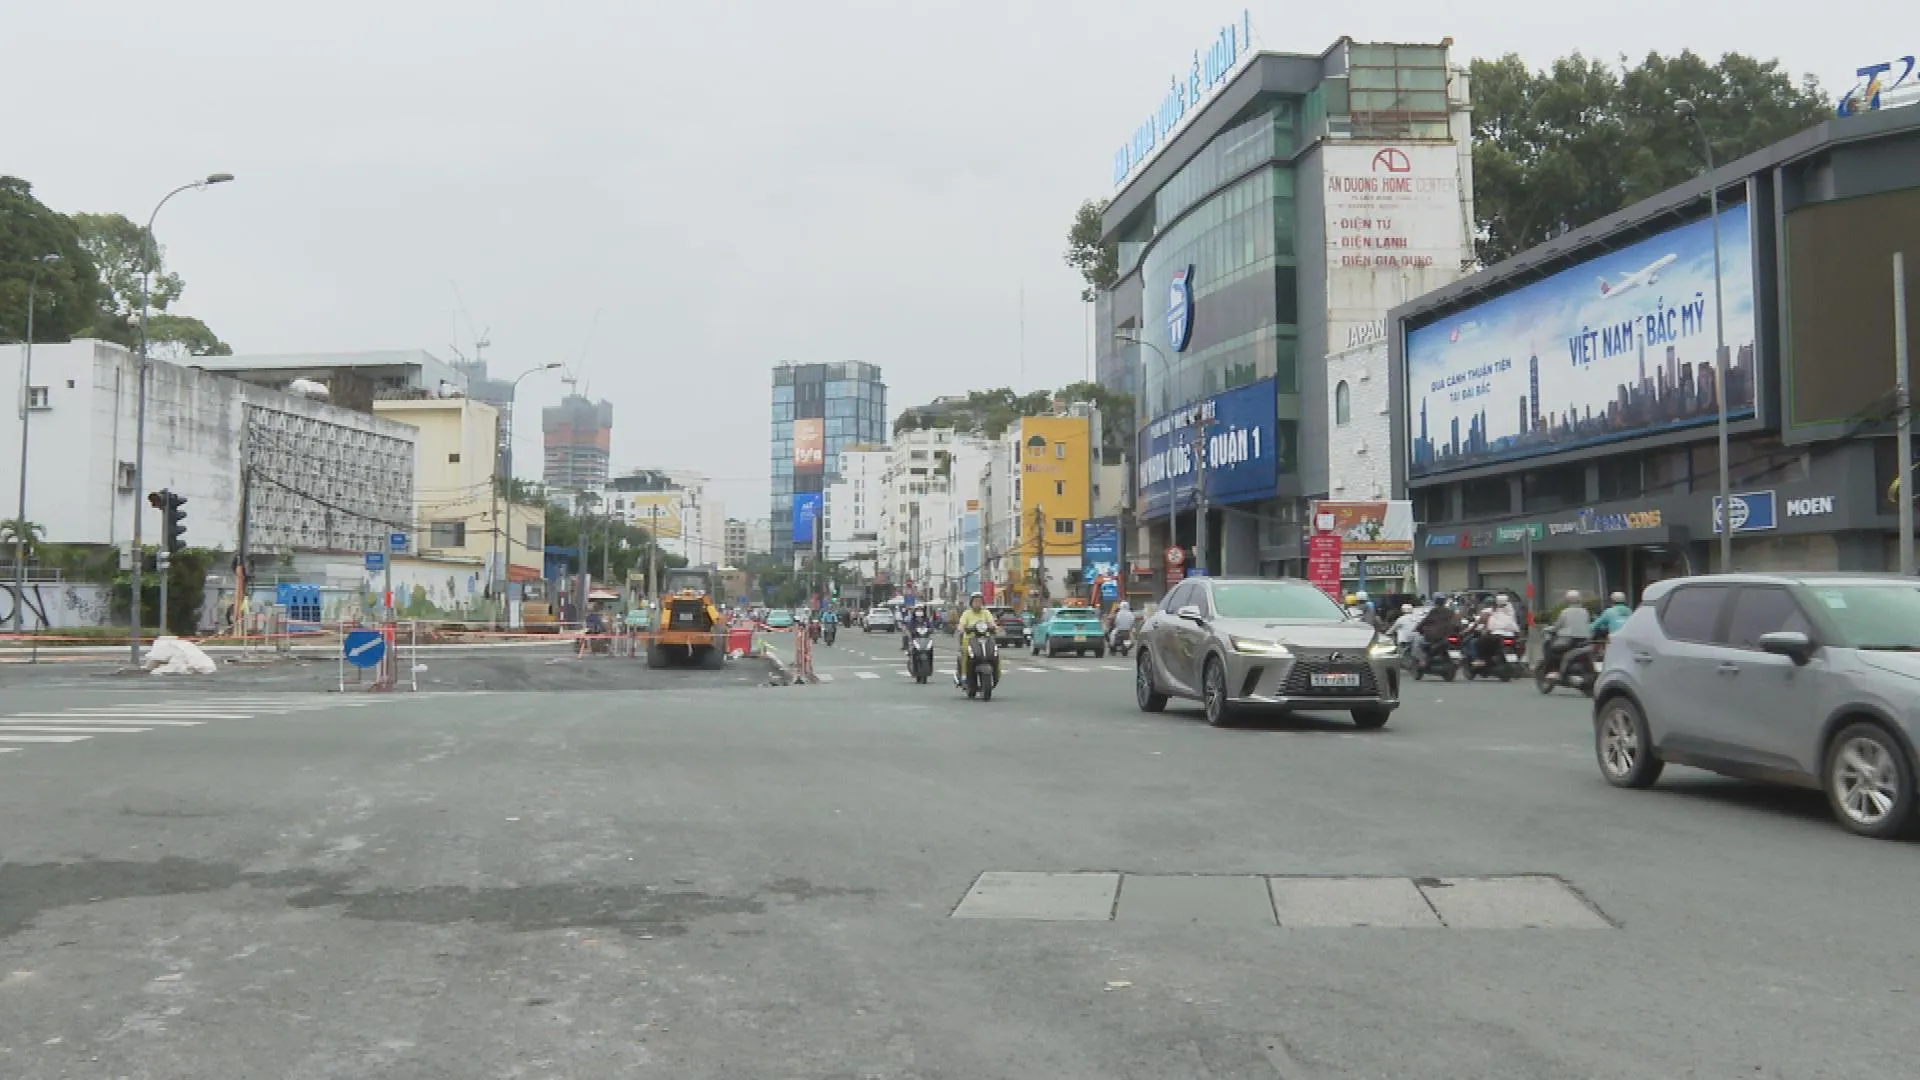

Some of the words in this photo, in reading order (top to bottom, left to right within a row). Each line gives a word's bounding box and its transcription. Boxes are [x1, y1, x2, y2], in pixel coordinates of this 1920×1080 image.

[1204, 24, 1236, 91] QUẬN
[1382, 177, 1413, 193] HOME
[1569, 326, 1598, 371] VIỆT
[1602, 320, 1633, 358] NAM
[1646, 296, 1677, 346] BẮC
[1681, 291, 1705, 338] MỸ
[1210, 424, 1249, 470] QUẬN
[1252, 425, 1261, 459] 1
[1786, 497, 1833, 517] MOEN
